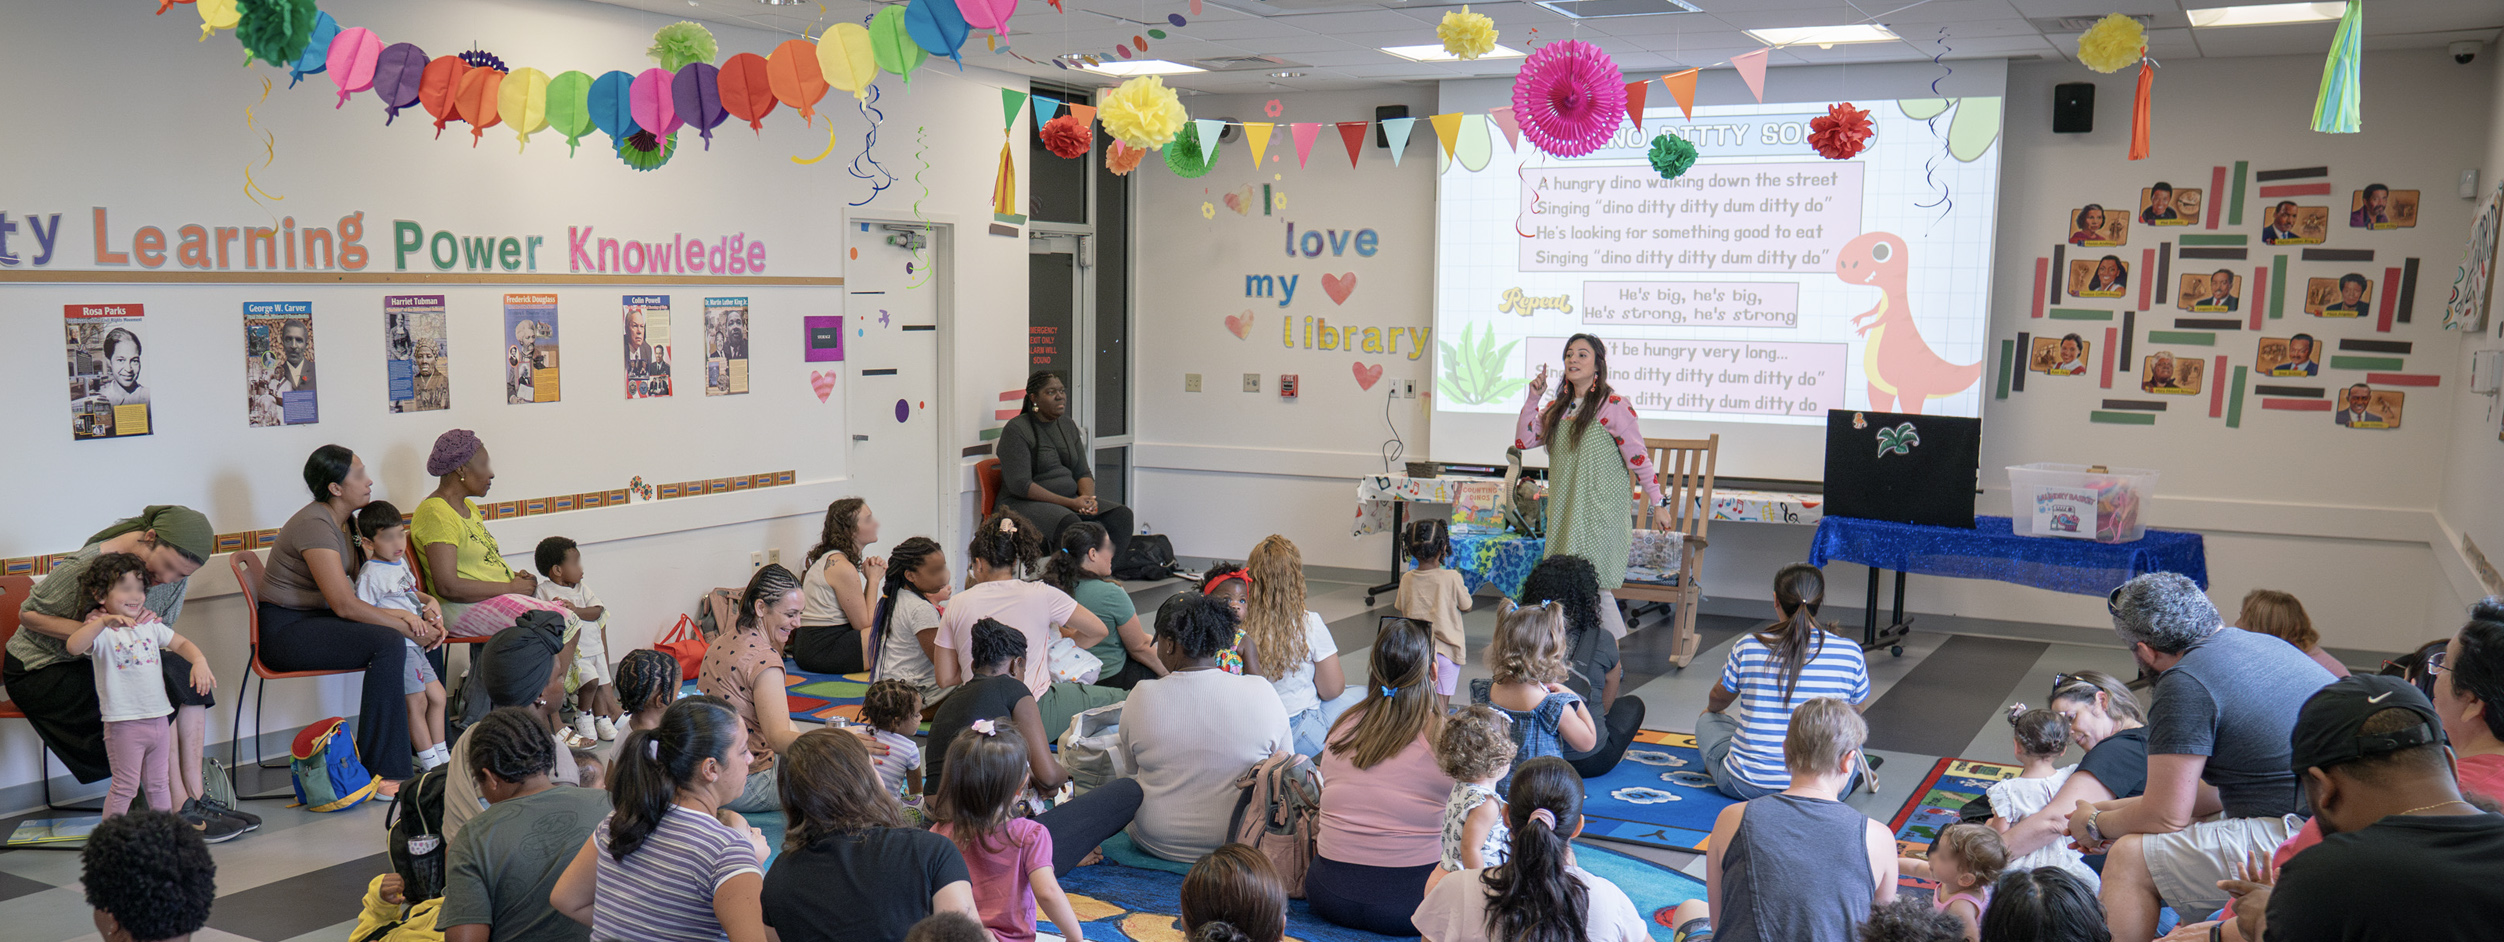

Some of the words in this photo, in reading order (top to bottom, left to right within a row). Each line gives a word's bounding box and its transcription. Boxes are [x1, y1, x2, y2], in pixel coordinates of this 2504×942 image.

[1761, 121, 1810, 145] SO
[1538, 176, 1549, 190] A
[1554, 176, 1606, 194] hungry
[1610, 175, 1642, 189] dino
[1708, 173, 1750, 187] down
[1755, 172, 1781, 187] the
[1786, 172, 1838, 186] street
[1537, 201, 1590, 218] Singing
[1638, 199, 1676, 218] ditty
[1680, 198, 1718, 218] ditty
[1723, 198, 1755, 212] dum
[1759, 197, 1799, 217] ditty
[93, 206, 370, 272] Learning
[393, 219, 543, 272] Power
[568, 225, 767, 274] Knowledge
[1286, 221, 1379, 258] love
[1536, 225, 1566, 239] He's
[1571, 225, 1621, 242] looking
[1626, 227, 1648, 239] for
[1652, 224, 1729, 242] something
[1734, 224, 1769, 242] good
[1775, 224, 1791, 239] to
[1796, 224, 1823, 239] eat
[1535, 250, 1589, 267] Singing
[1636, 250, 1674, 269] ditty
[1678, 250, 1716, 269] ditty
[1721, 250, 1752, 264] dum
[1757, 250, 1797, 269] ditty
[391, 297, 413, 305] Harriet
[414, 297, 438, 305] Tubman
[1245, 274, 1299, 308] my
[1498, 286, 1574, 317] Repeat
[1619, 287, 1650, 301] He's
[1657, 288, 1686, 305] big,
[1693, 288, 1725, 302] he's
[1733, 289, 1763, 306] big,
[82, 307, 103, 316] Rosa
[104, 306, 127, 315] Parks
[248, 304, 273, 314] George
[274, 304, 283, 312] W.
[284, 304, 306, 312] Carver
[1584, 306, 1615, 319] He's
[1621, 307, 1687, 324] strong,
[1694, 307, 1726, 321] he's
[1733, 308, 1796, 326] strong
[1041, 336, 1055, 344] ONLY
[1283, 315, 1432, 360] library
[1029, 346, 1045, 354] LARM
[1033, 356, 1051, 364] SOUND
[1623, 342, 1639, 356] be
[1644, 342, 1697, 362] hungry
[1702, 347, 1740, 363] very
[1745, 344, 1788, 363] long...
[1634, 367, 1671, 386] ditty
[1676, 368, 1714, 387] ditty
[1718, 369, 1749, 384] dum
[1754, 370, 1793, 390] ditty
[1635, 392, 1672, 410] ditty
[1677, 393, 1715, 412] ditty
[1719, 394, 1750, 409] dum
[1755, 395, 1794, 415] ditty
[1799, 397, 1817, 411] do
